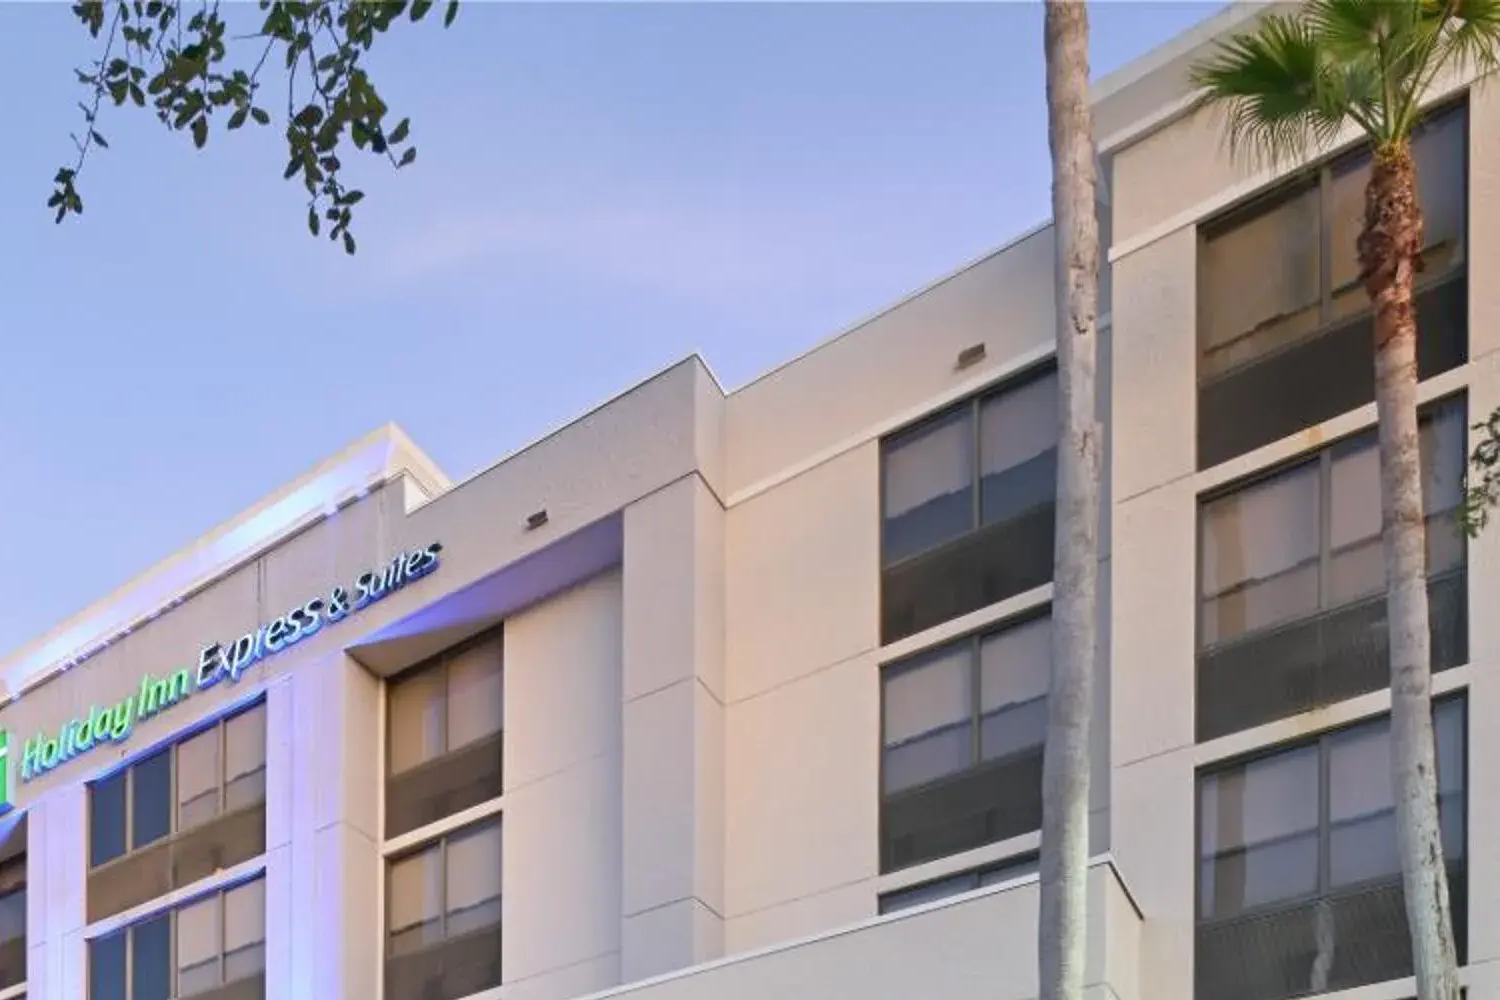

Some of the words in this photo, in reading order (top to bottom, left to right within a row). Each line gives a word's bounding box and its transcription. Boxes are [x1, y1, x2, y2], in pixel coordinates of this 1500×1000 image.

[21, 697, 134, 782] Holiday
[137, 668, 190, 723] Inn
[197, 597, 325, 686] Express
[327, 584, 350, 624] &
[354, 542, 442, 610] Suites
